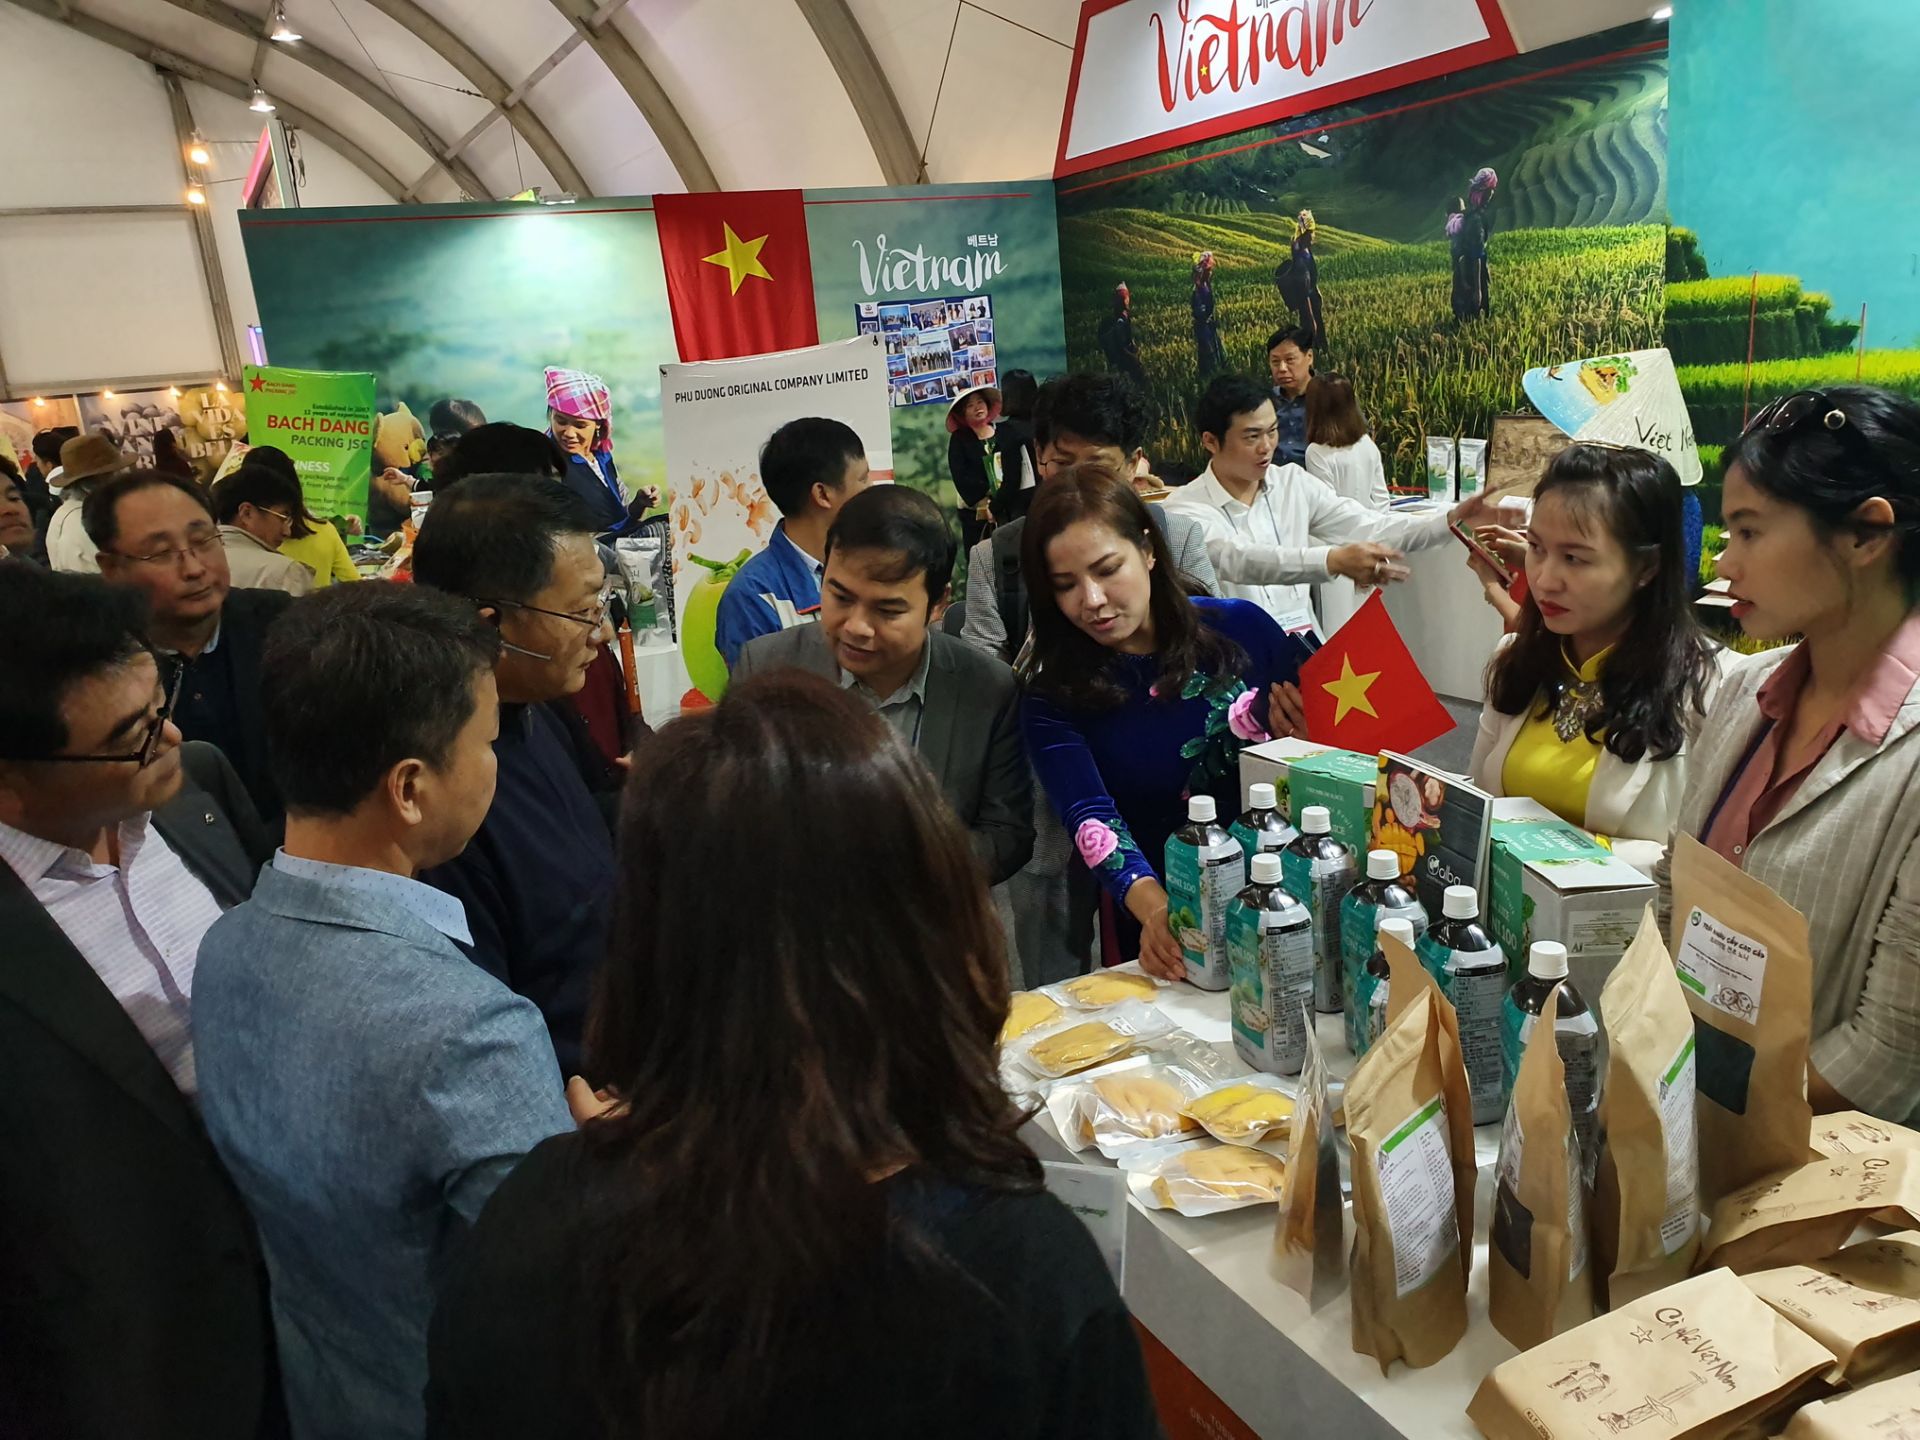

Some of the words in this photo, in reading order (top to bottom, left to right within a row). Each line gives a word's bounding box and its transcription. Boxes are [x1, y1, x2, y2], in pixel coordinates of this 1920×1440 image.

[1150, 0, 1374, 112] Vietnam
[967, 233, 998, 247] 베트남
[852, 234, 1008, 295] Vietnam
[675, 390, 693, 403] PHU
[695, 387, 726, 400] DUONG
[728, 381, 772, 397] ORIGINAL
[775, 374, 823, 391] COMPANY
[826, 368, 868, 384] LIMITED
[200, 393, 231, 408] LA
[192, 408, 246, 425] VIDA
[267, 415, 314, 431] BACH
[320, 418, 369, 435] DANG
[291, 435, 343, 448] PACKING
[347, 439, 369, 450] JSC
